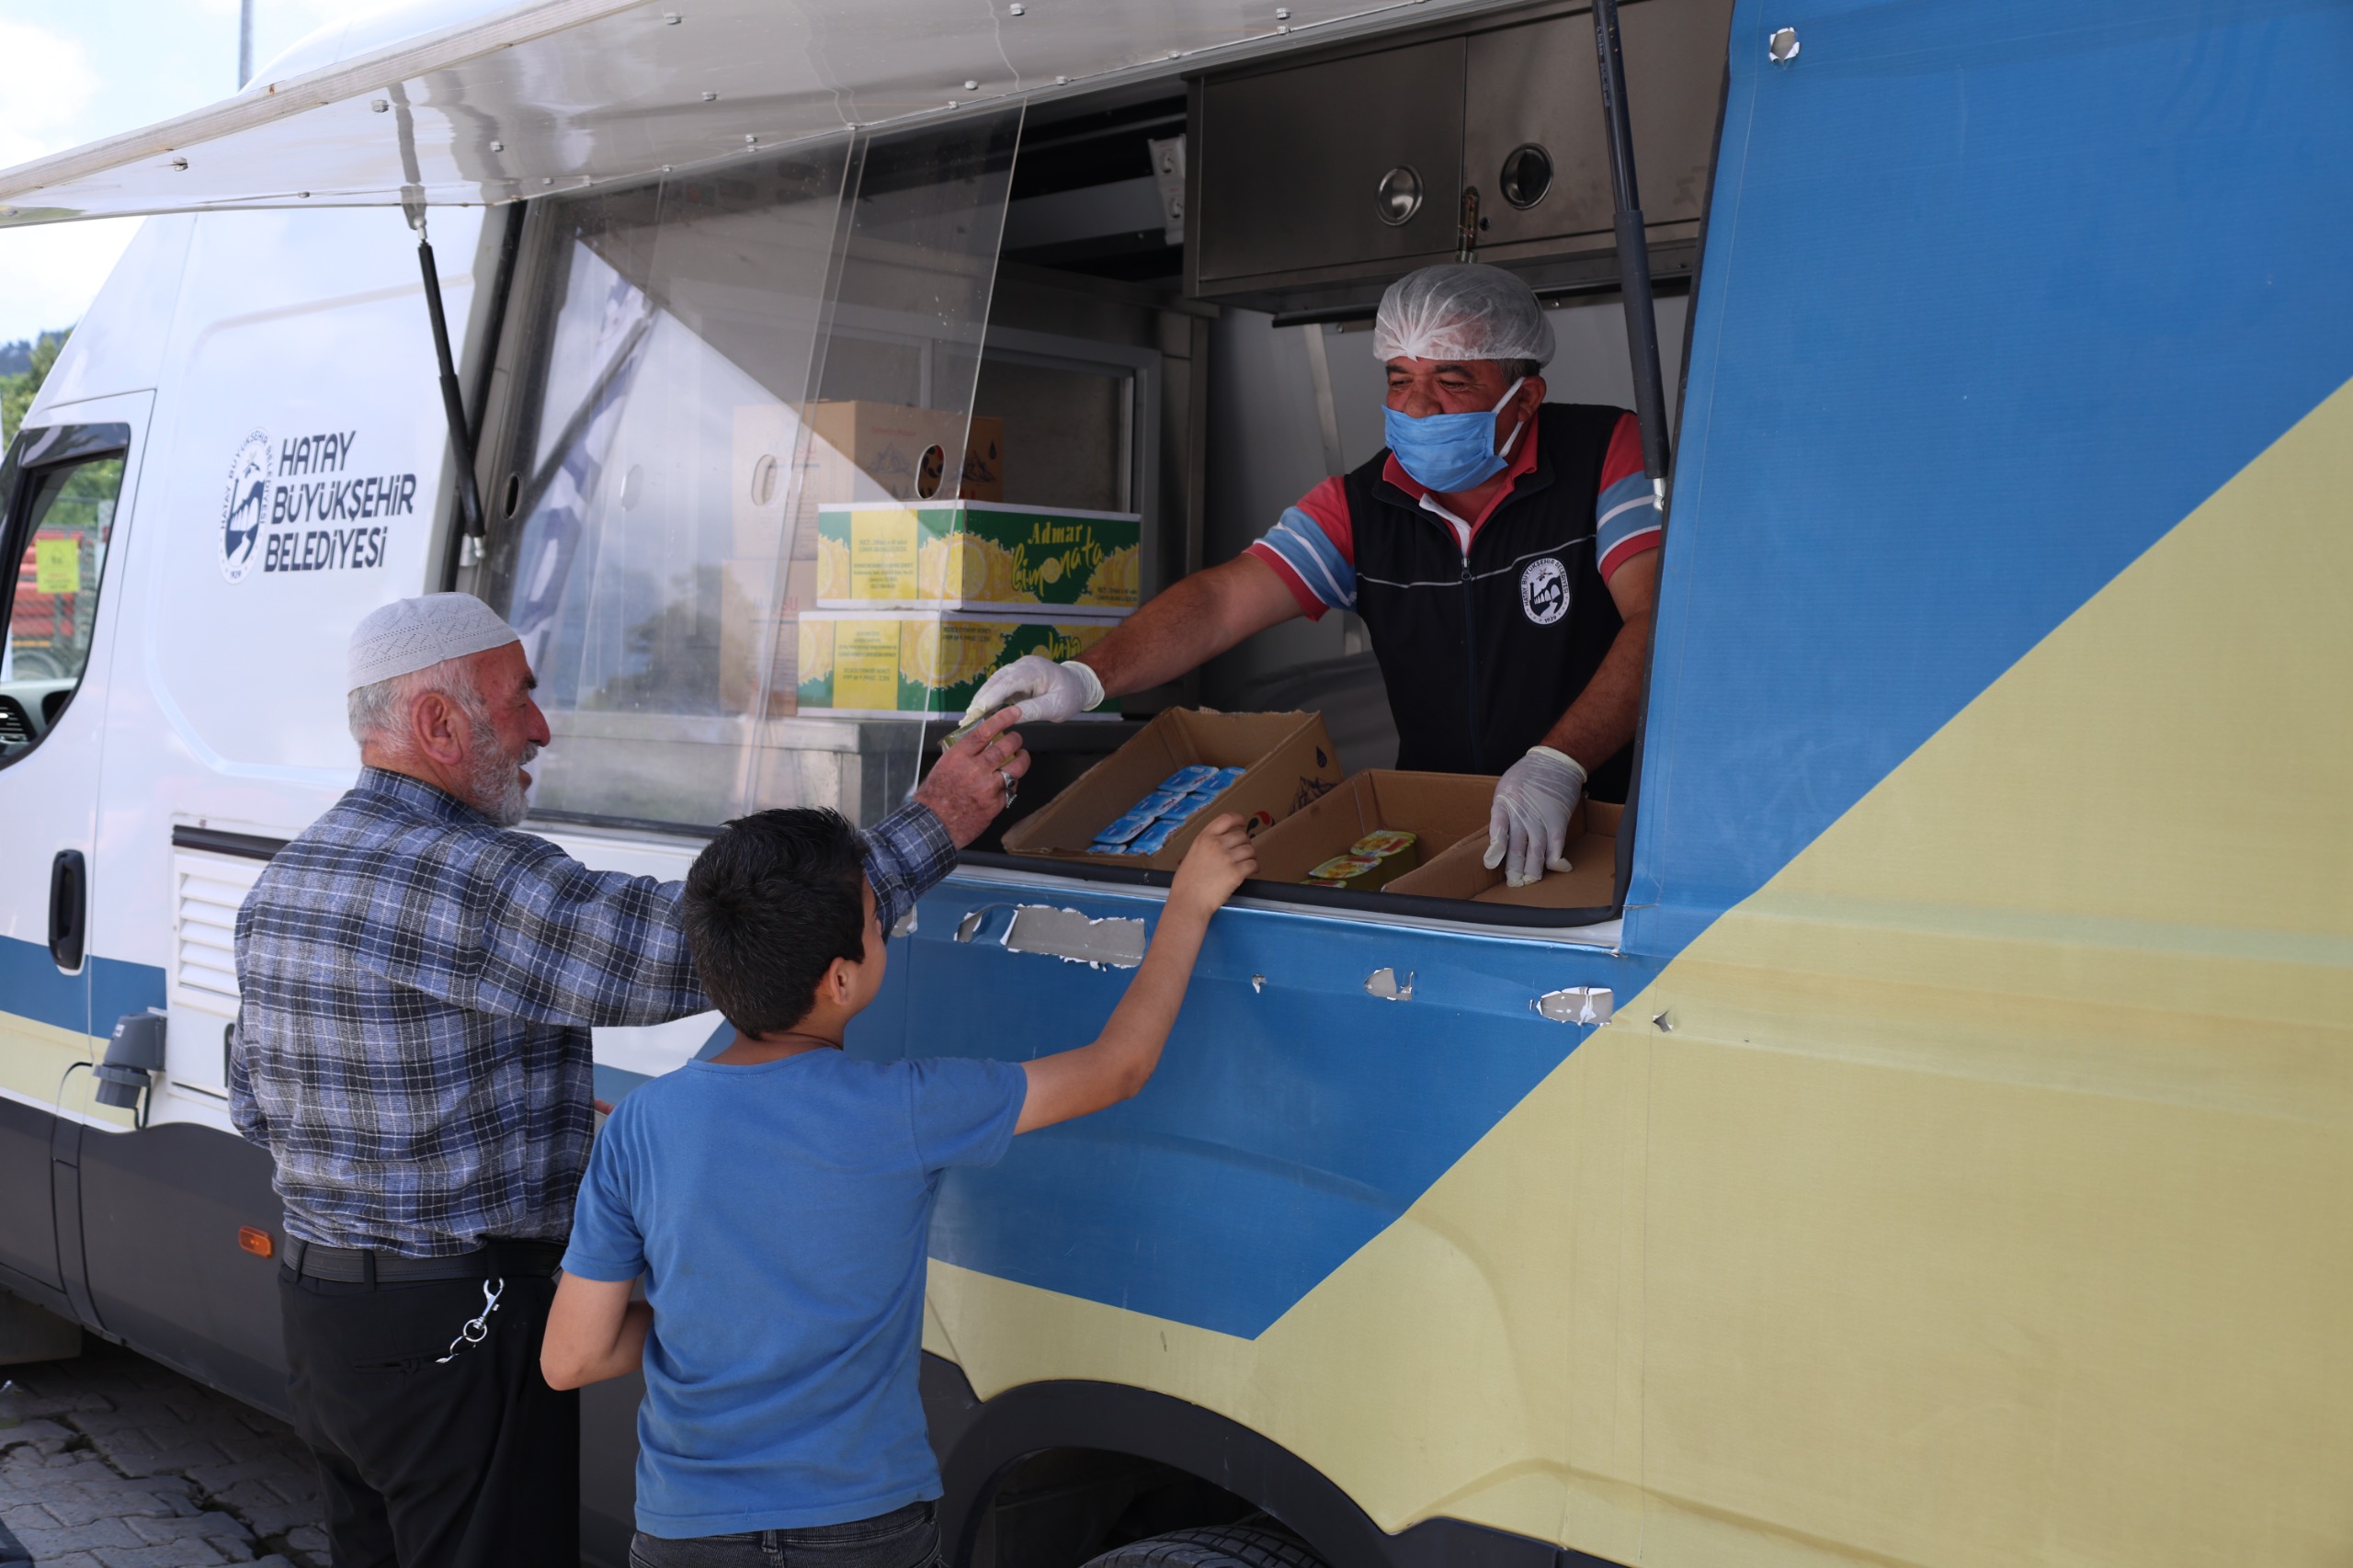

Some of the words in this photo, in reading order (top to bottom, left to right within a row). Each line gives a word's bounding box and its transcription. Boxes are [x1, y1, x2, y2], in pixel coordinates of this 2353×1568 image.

[278, 430, 357, 477] HATAY
[270, 473, 416, 525] BÜYÜKŞEHİR
[263, 526, 388, 573] BELEDİYESİ
[1027, 521, 1083, 544] Admar
[1544, 615, 1557, 623] 1939
